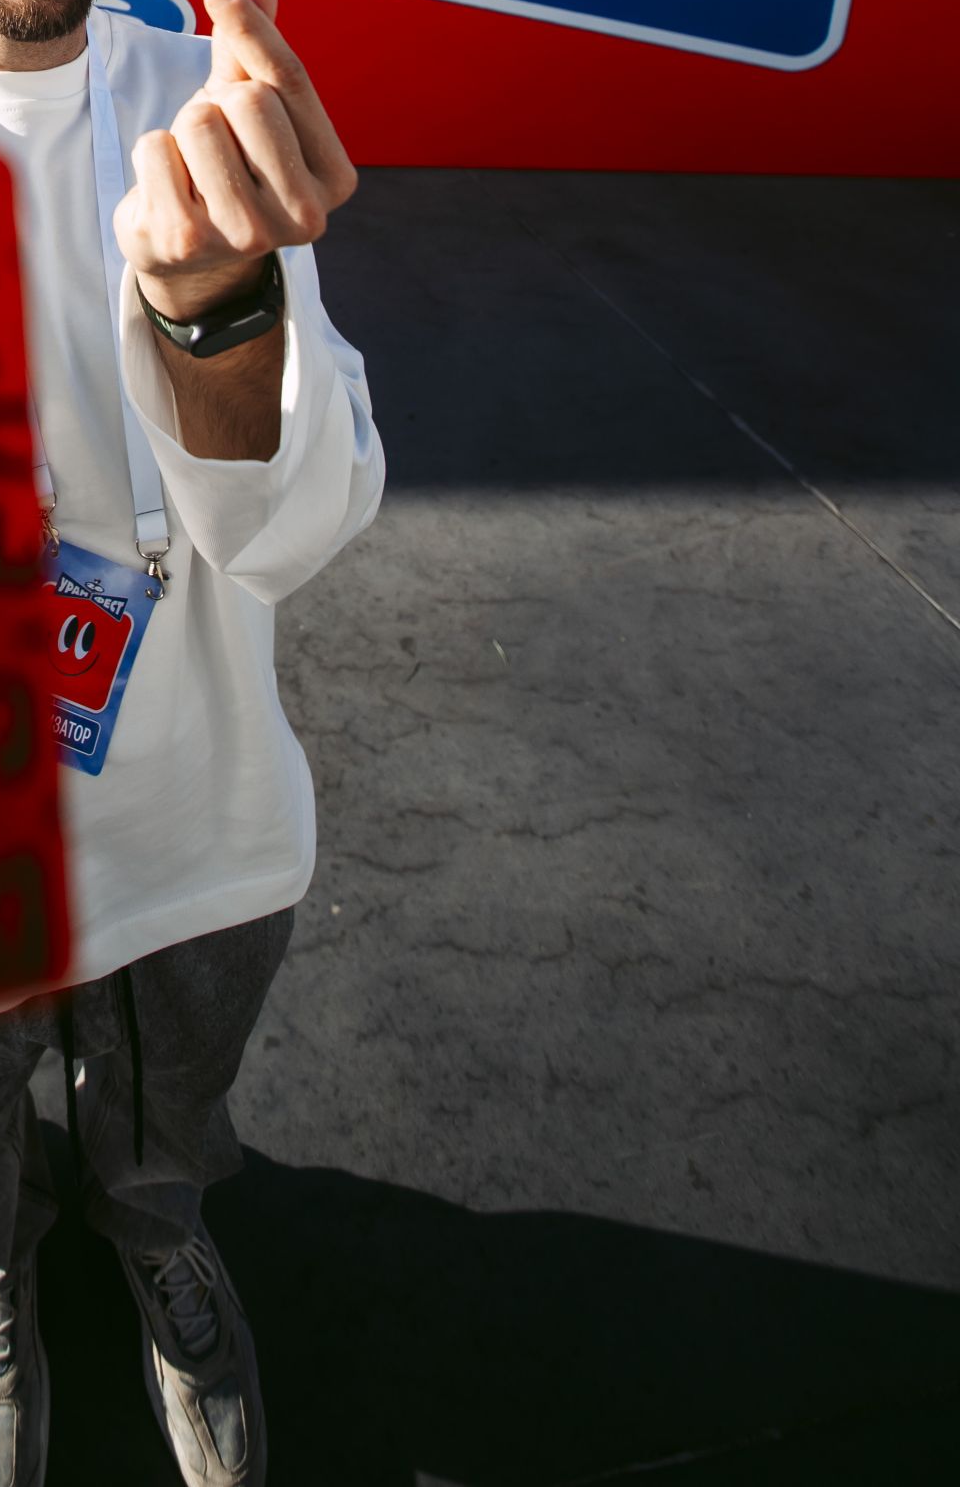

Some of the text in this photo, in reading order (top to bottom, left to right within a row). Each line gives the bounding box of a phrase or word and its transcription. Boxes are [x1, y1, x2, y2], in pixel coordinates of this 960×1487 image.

[58, 576, 125, 616] УРАМ ФЕСТ
[51, 714, 92, 744] ЗАТОР
